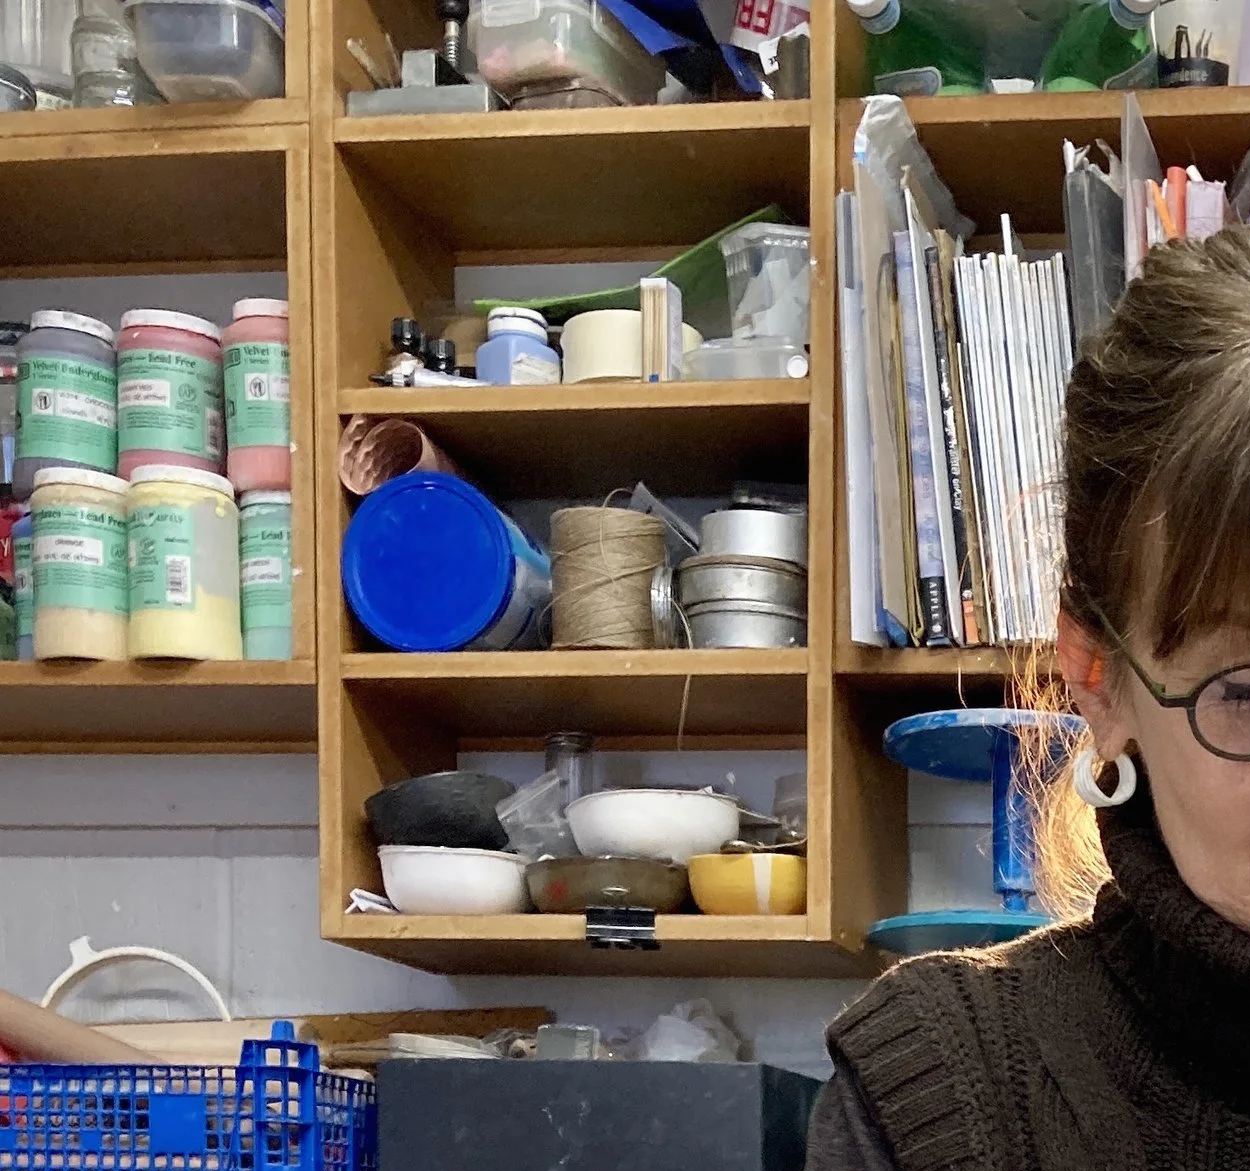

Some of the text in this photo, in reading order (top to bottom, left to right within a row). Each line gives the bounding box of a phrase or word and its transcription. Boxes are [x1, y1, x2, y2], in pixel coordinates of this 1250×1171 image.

[243, 345, 270, 356] Velvet
[148, 353, 196, 368] Lead Free
[80, 510, 105, 524] Lead
[261, 530, 283, 540] Lead
[927, 581, 941, 620] APPLE
